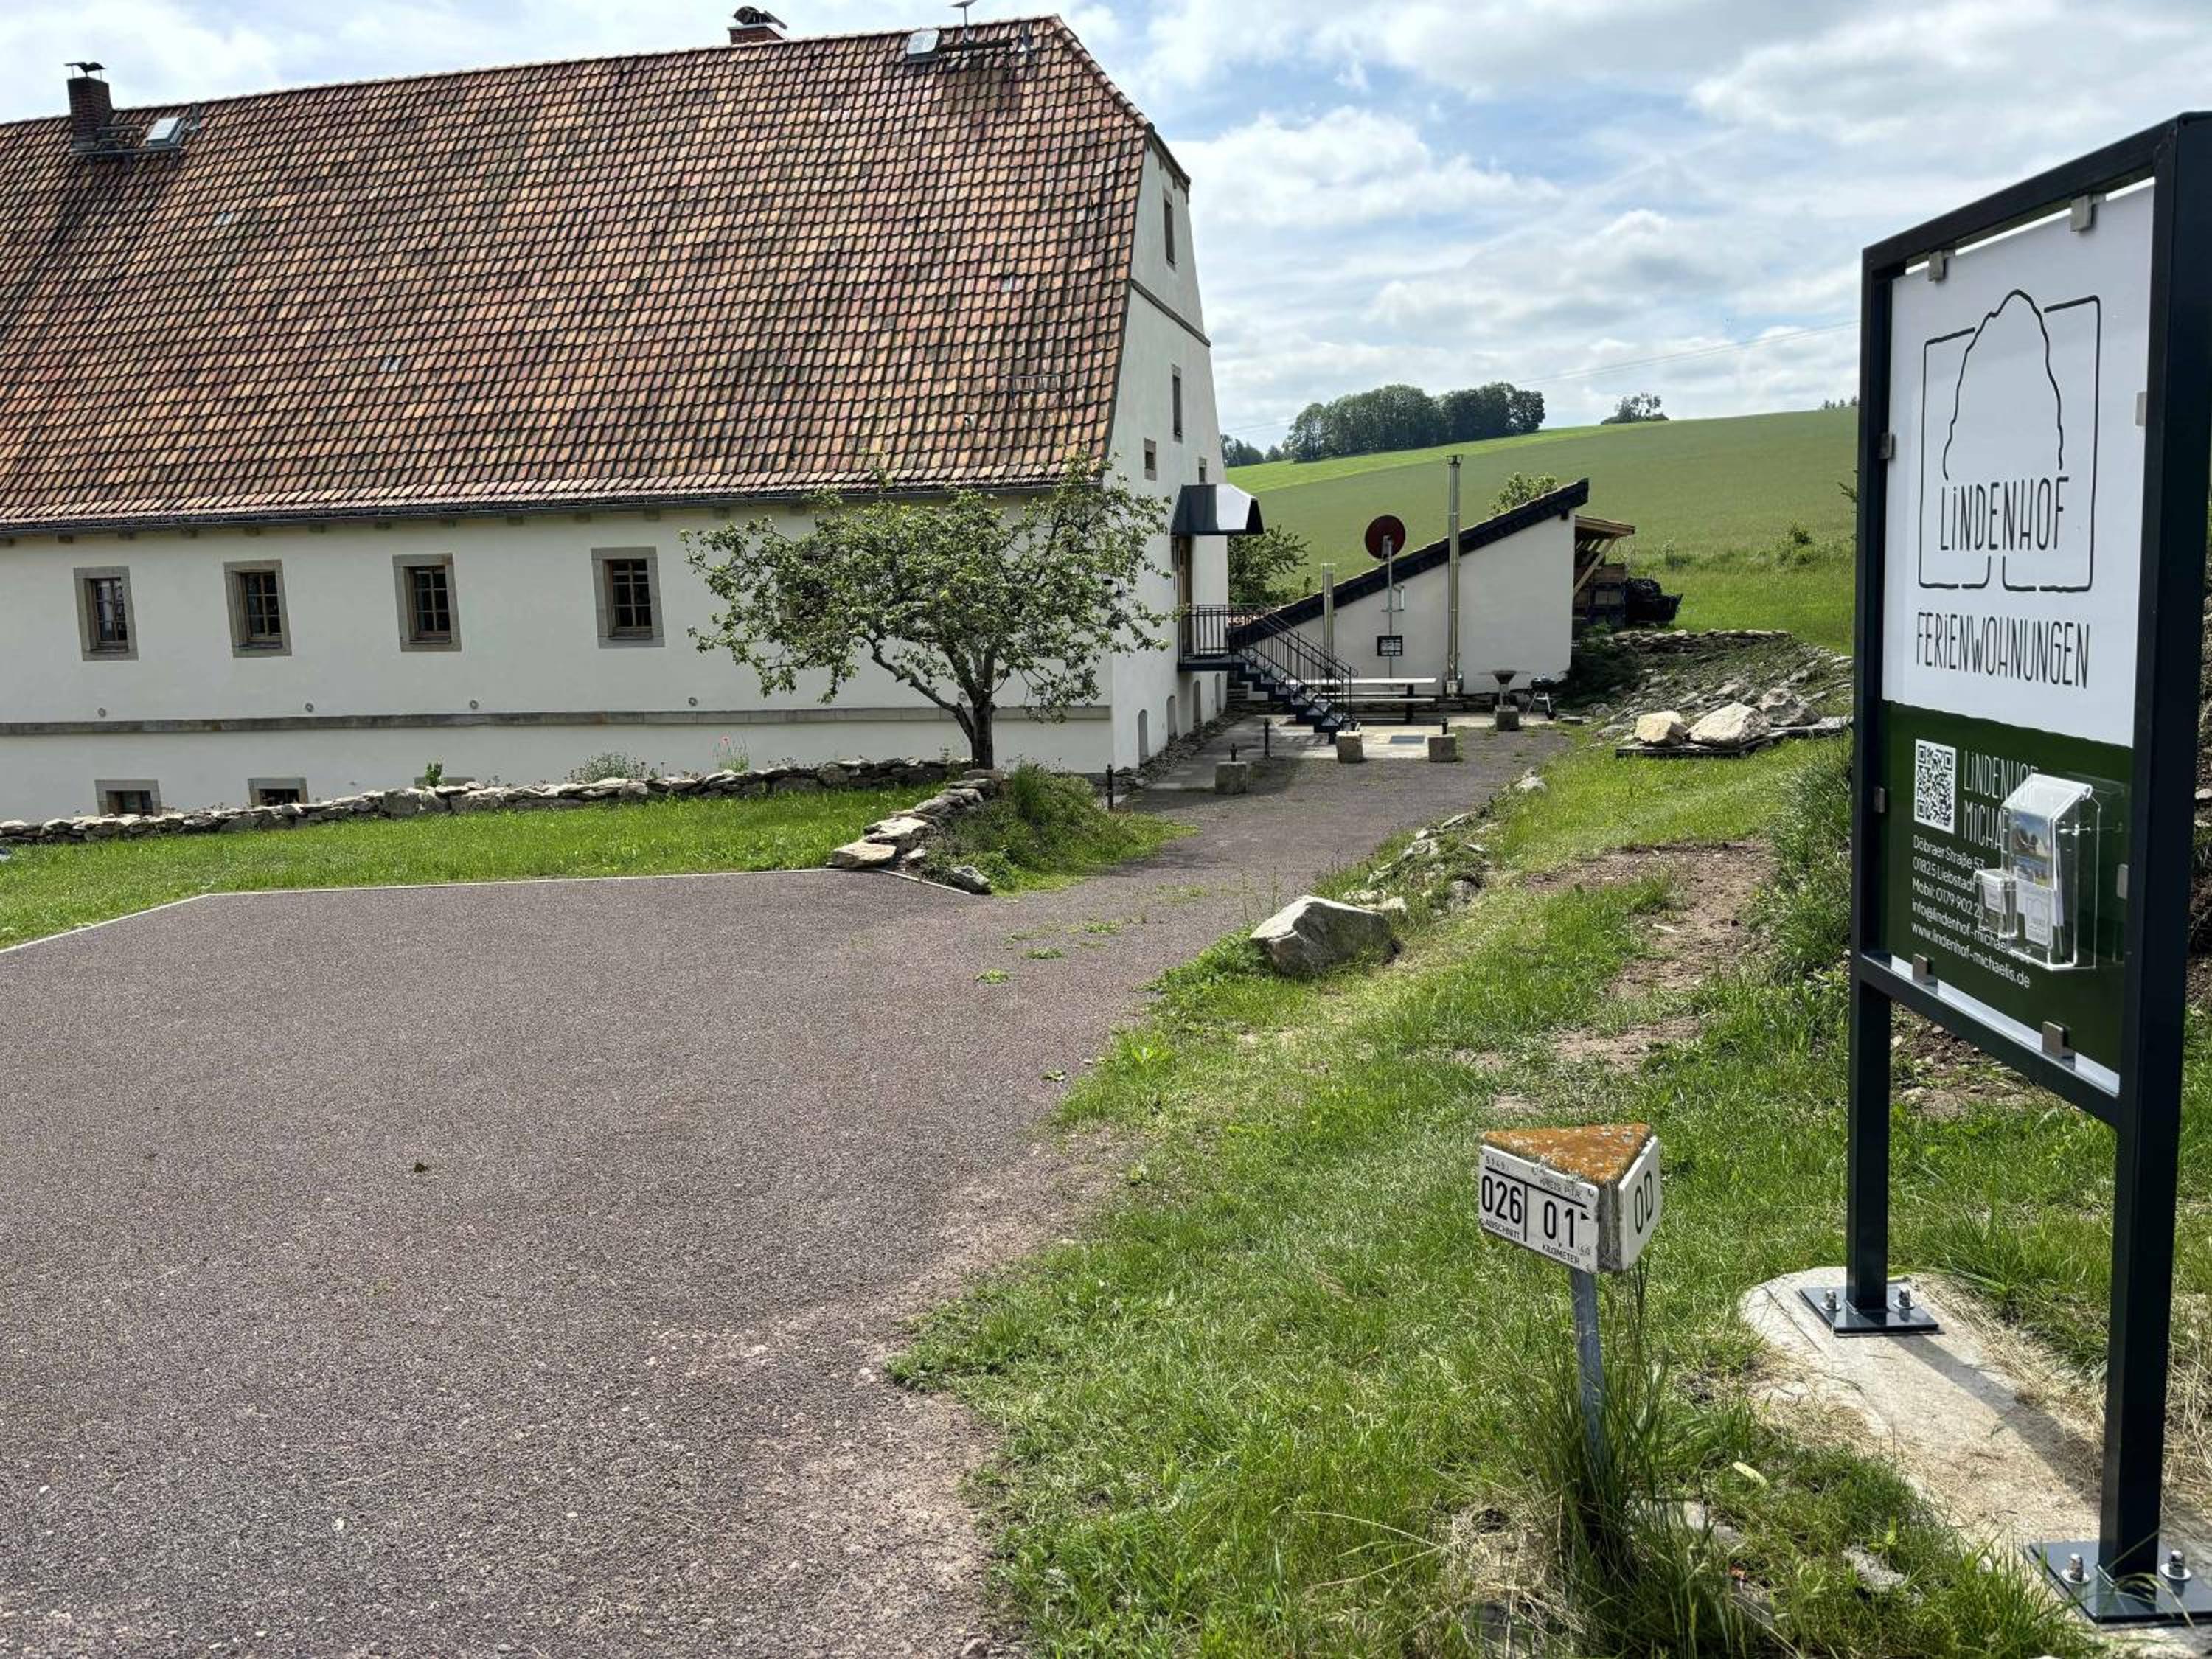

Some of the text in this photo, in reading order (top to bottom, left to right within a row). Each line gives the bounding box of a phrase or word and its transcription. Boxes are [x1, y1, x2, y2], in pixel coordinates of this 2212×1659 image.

[1912, 856, 1936, 878] 01825
[1913, 834, 1944, 858] Döbraer
[1945, 846, 1973, 870] Straße
[1912, 877, 1935, 900] Mobil:
[1935, 887, 1955, 905] 0179
[1956, 894, 1973, 916] 902
[1481, 1175, 1522, 1225] 026
[1542, 1242, 1580, 1266] KILOMETER
